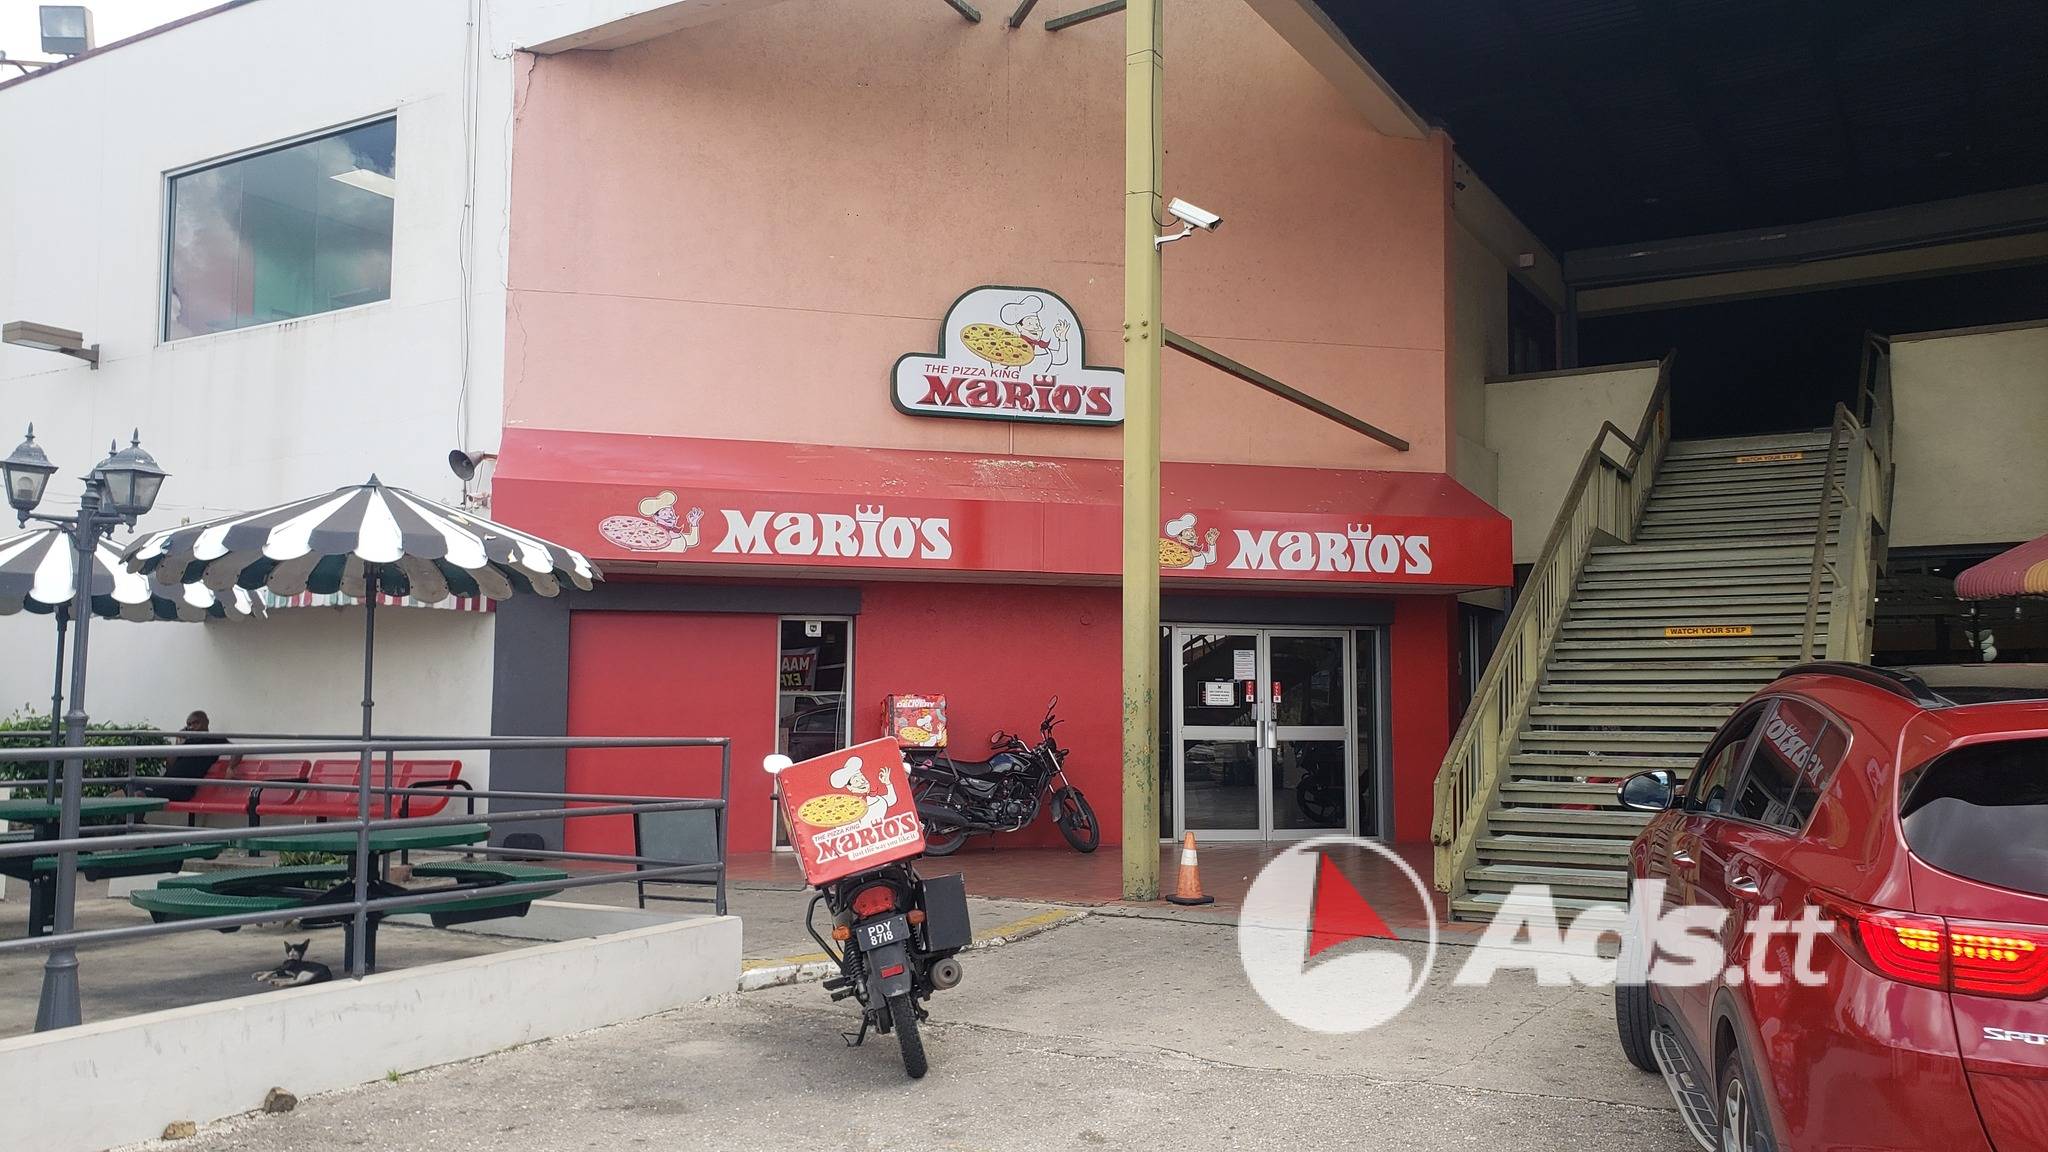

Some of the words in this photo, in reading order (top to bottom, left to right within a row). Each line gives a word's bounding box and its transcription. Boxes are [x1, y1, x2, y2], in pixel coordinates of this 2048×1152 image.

[924, 364, 949, 374] THE
[951, 366, 986, 377] PIZZA
[990, 368, 1020, 380] KING
[1670, 627, 1699, 635] WATCH
[1700, 626, 1724, 634] YOUR
[814, 834, 826, 843] THE
[827, 828, 844, 838] PIZZA
[844, 823, 860, 833] KING
[867, 921, 891, 937] PDY
[870, 930, 894, 946] 8718
